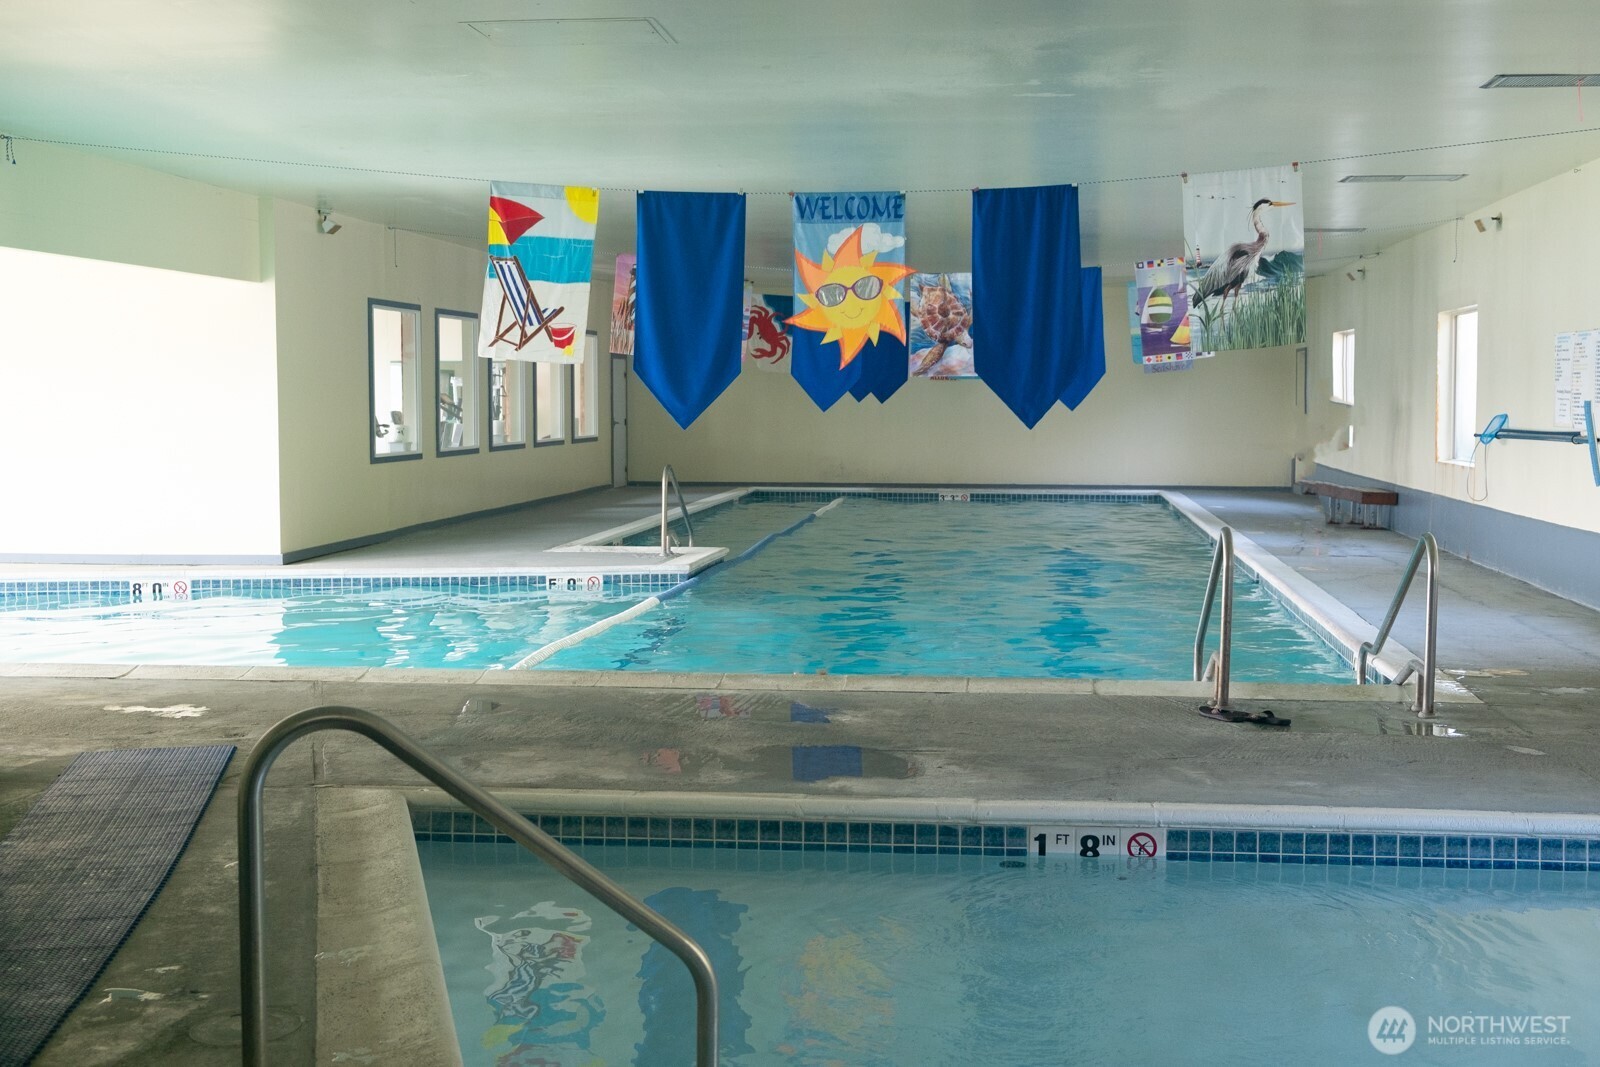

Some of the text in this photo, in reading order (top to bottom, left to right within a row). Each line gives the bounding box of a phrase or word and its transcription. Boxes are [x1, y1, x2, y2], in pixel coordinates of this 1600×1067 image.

[795, 195, 904, 220] WELCOME
[1034, 833, 1116, 858] 1 FT 8 IN
